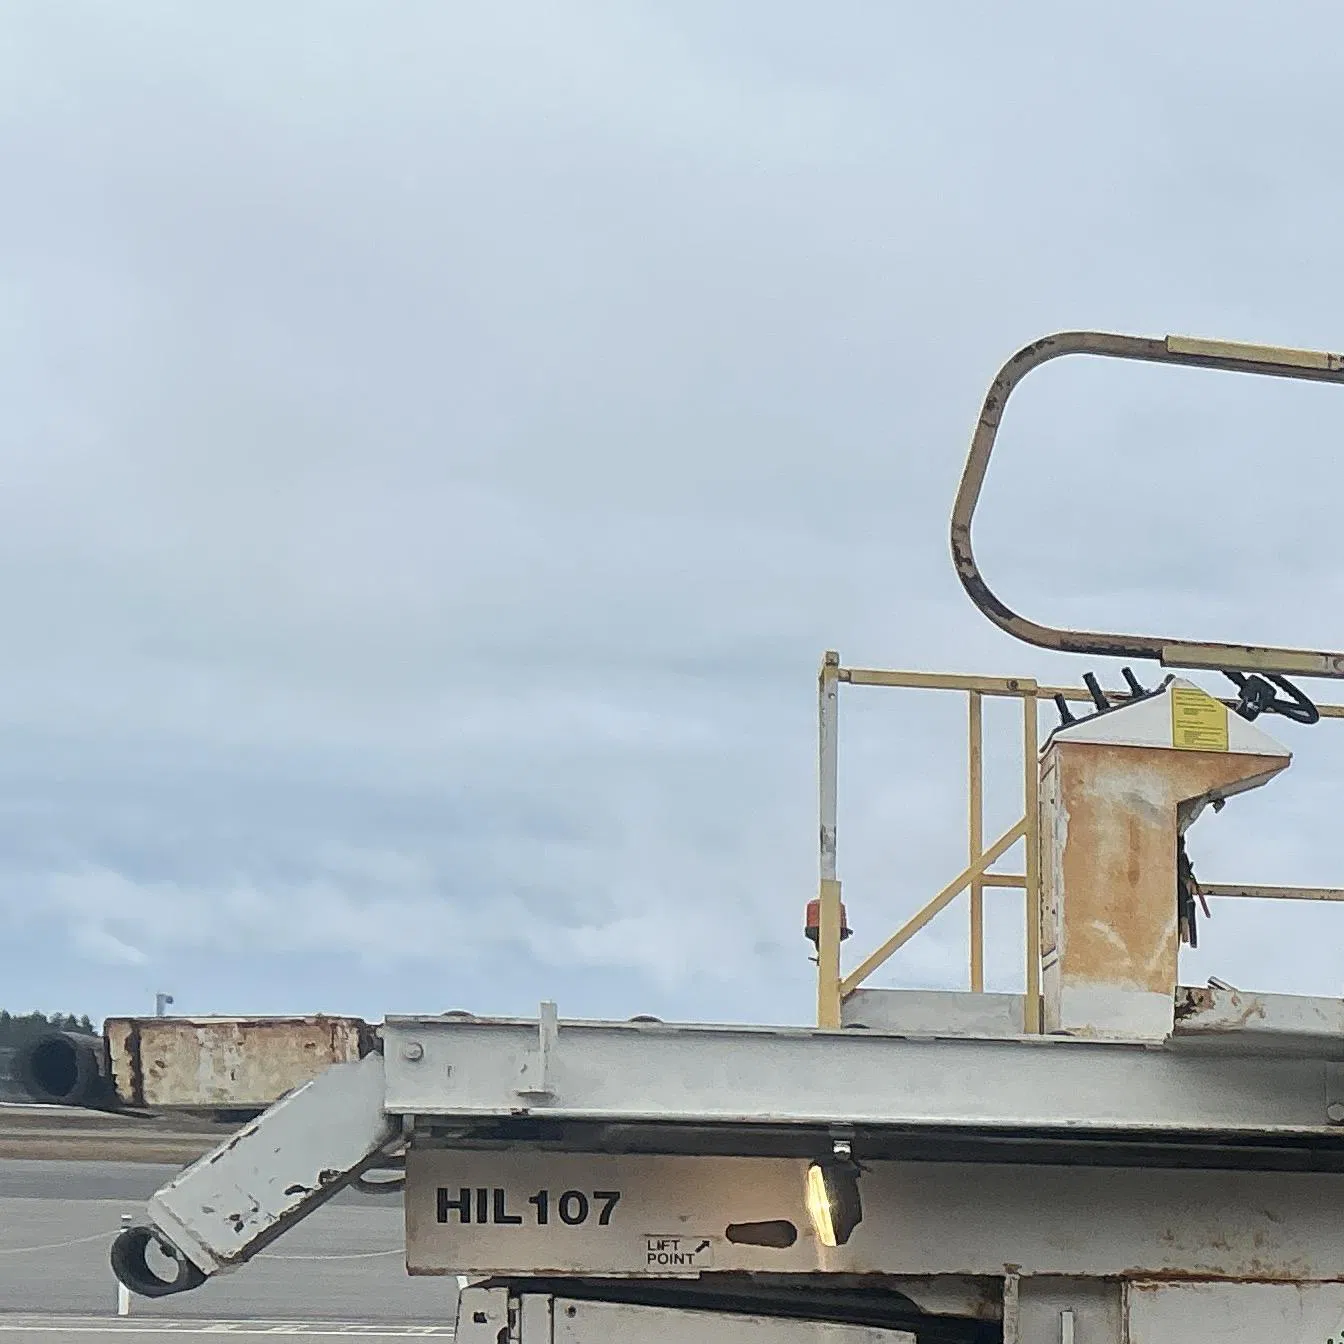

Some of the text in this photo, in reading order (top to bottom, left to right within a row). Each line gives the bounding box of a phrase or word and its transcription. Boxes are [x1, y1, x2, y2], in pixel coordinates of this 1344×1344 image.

[437, 1187, 621, 1226] HIL107
[647, 1239, 681, 1251] LIFT
[647, 1252, 696, 1265] POINT
